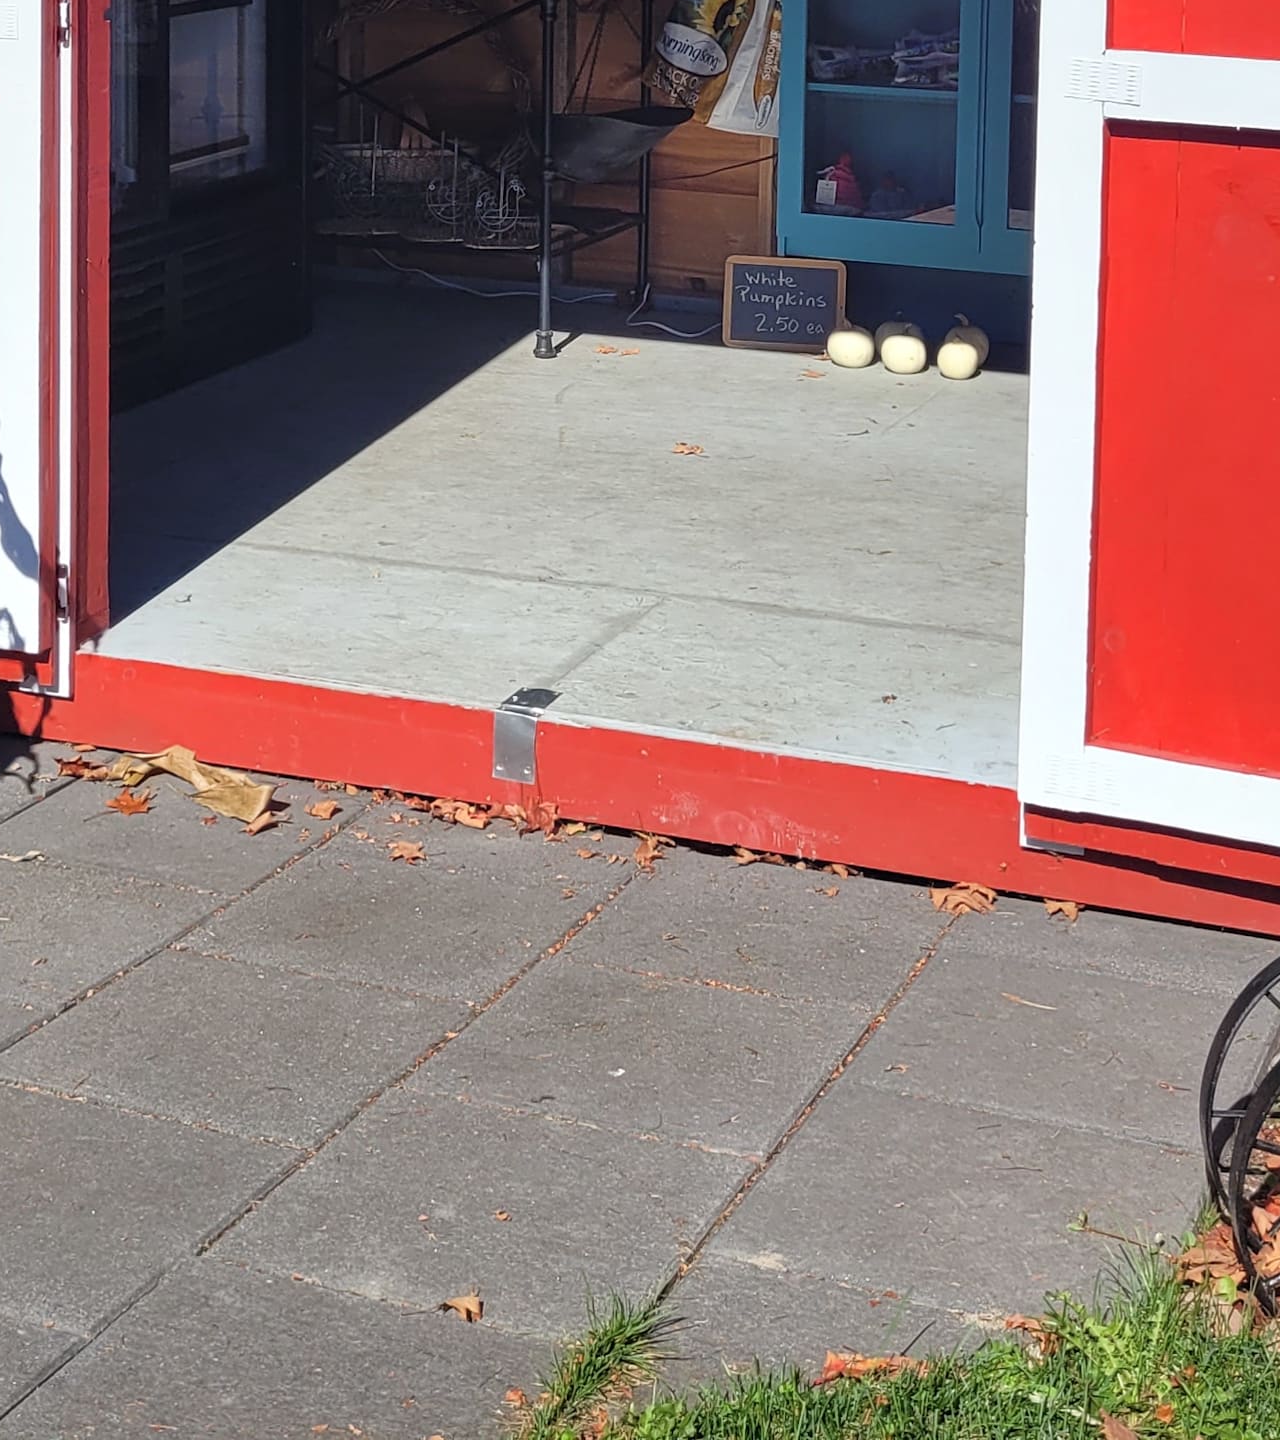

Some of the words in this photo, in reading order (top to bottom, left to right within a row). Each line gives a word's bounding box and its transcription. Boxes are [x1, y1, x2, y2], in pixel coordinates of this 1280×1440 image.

[735, 284, 827, 311] Pumpkins
[754, 312, 800, 334] 2.50
[806, 322, 826, 335] ea
